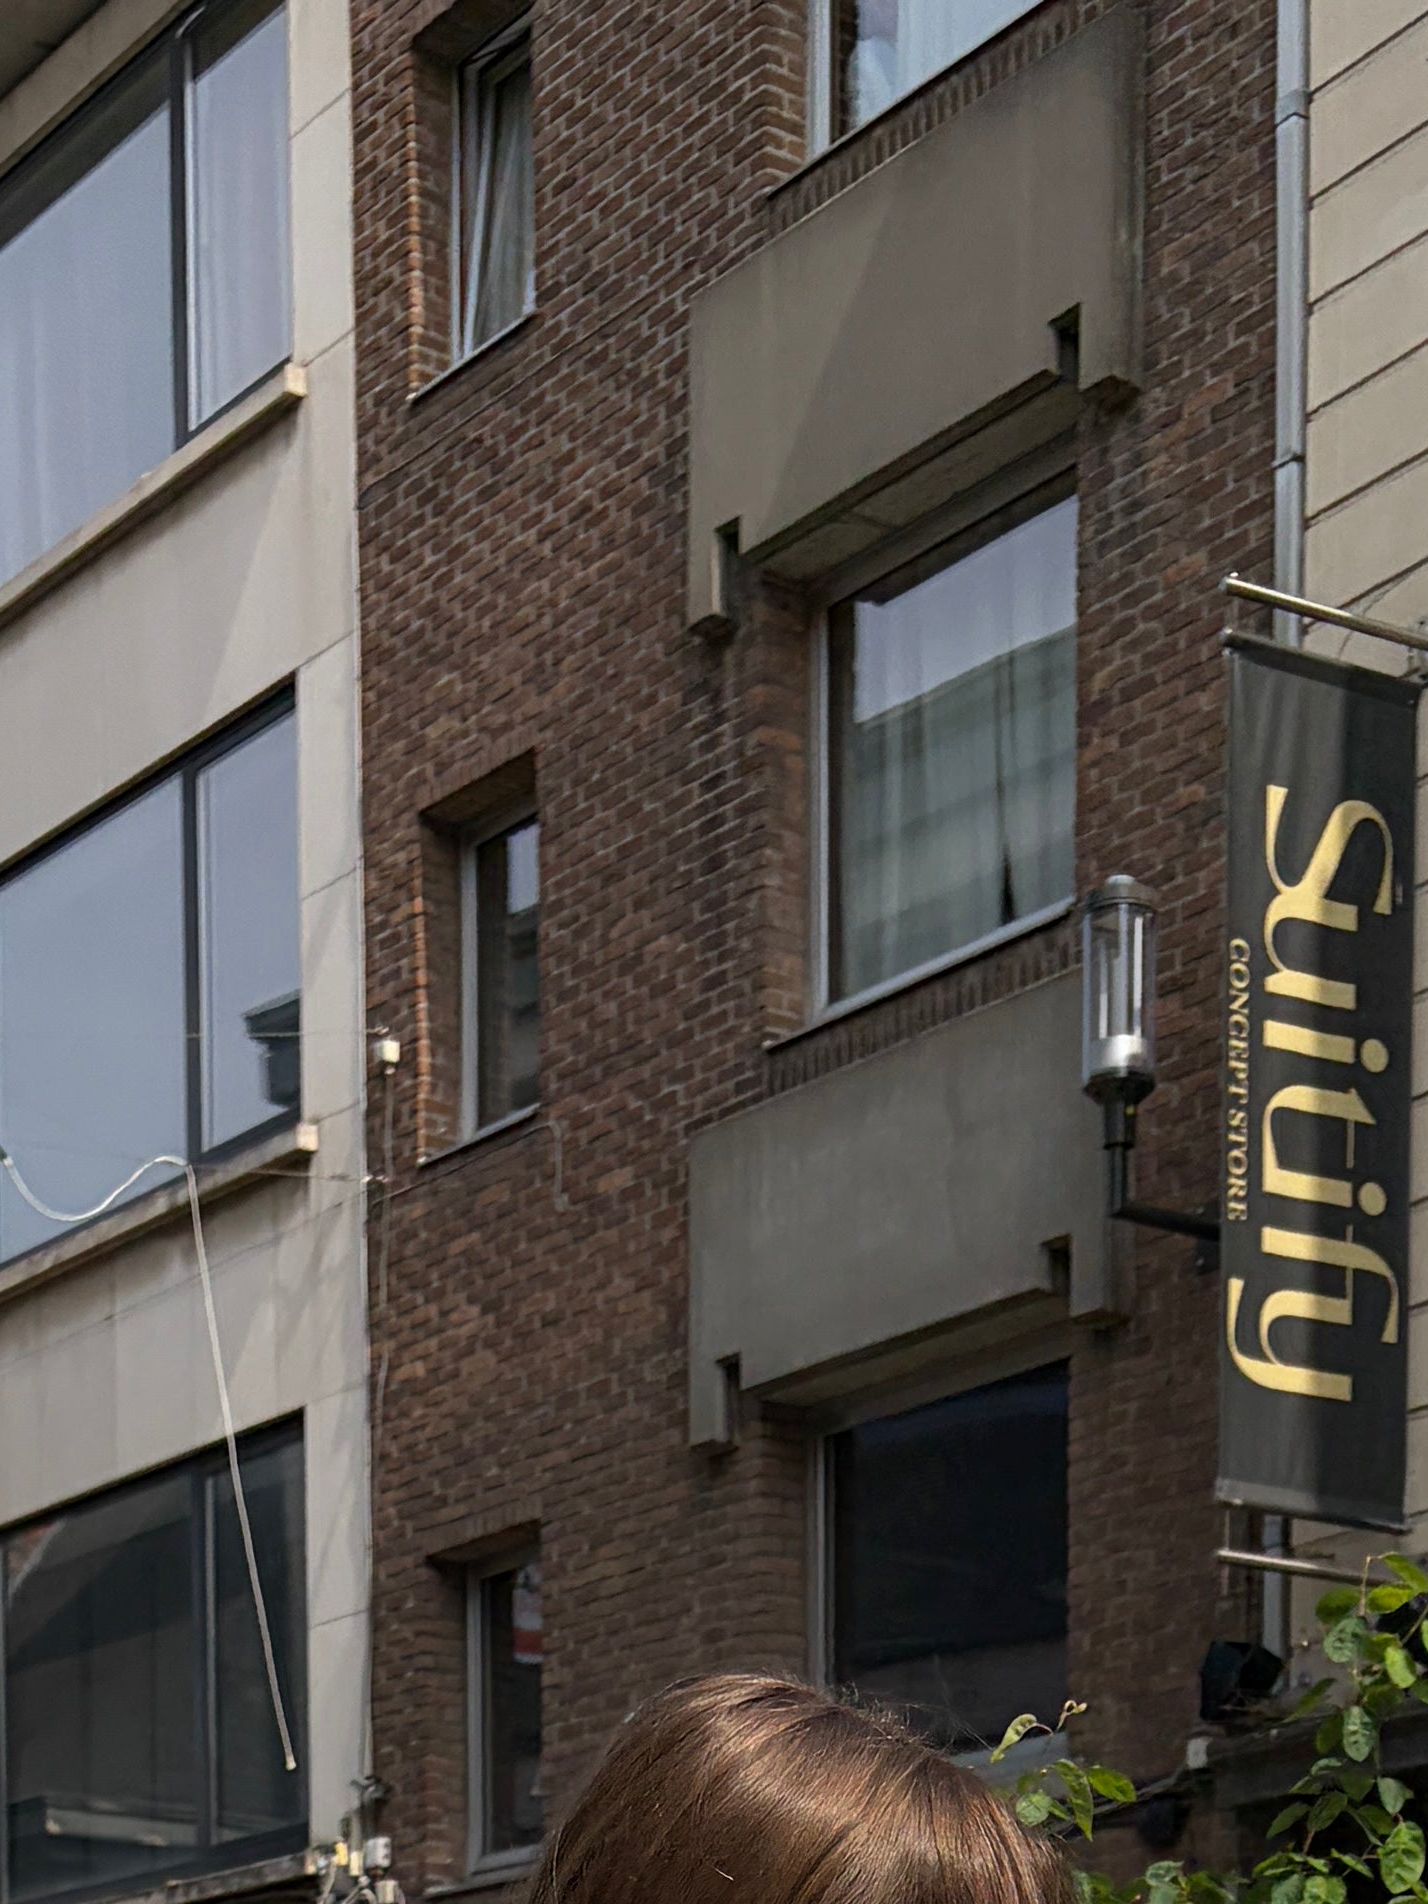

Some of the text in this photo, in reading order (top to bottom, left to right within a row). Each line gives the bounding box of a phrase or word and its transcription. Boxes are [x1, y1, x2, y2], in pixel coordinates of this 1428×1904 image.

[1226, 937, 1252, 1222] CONCEPT STORE
[1228, 785, 1399, 1401] Suitify
